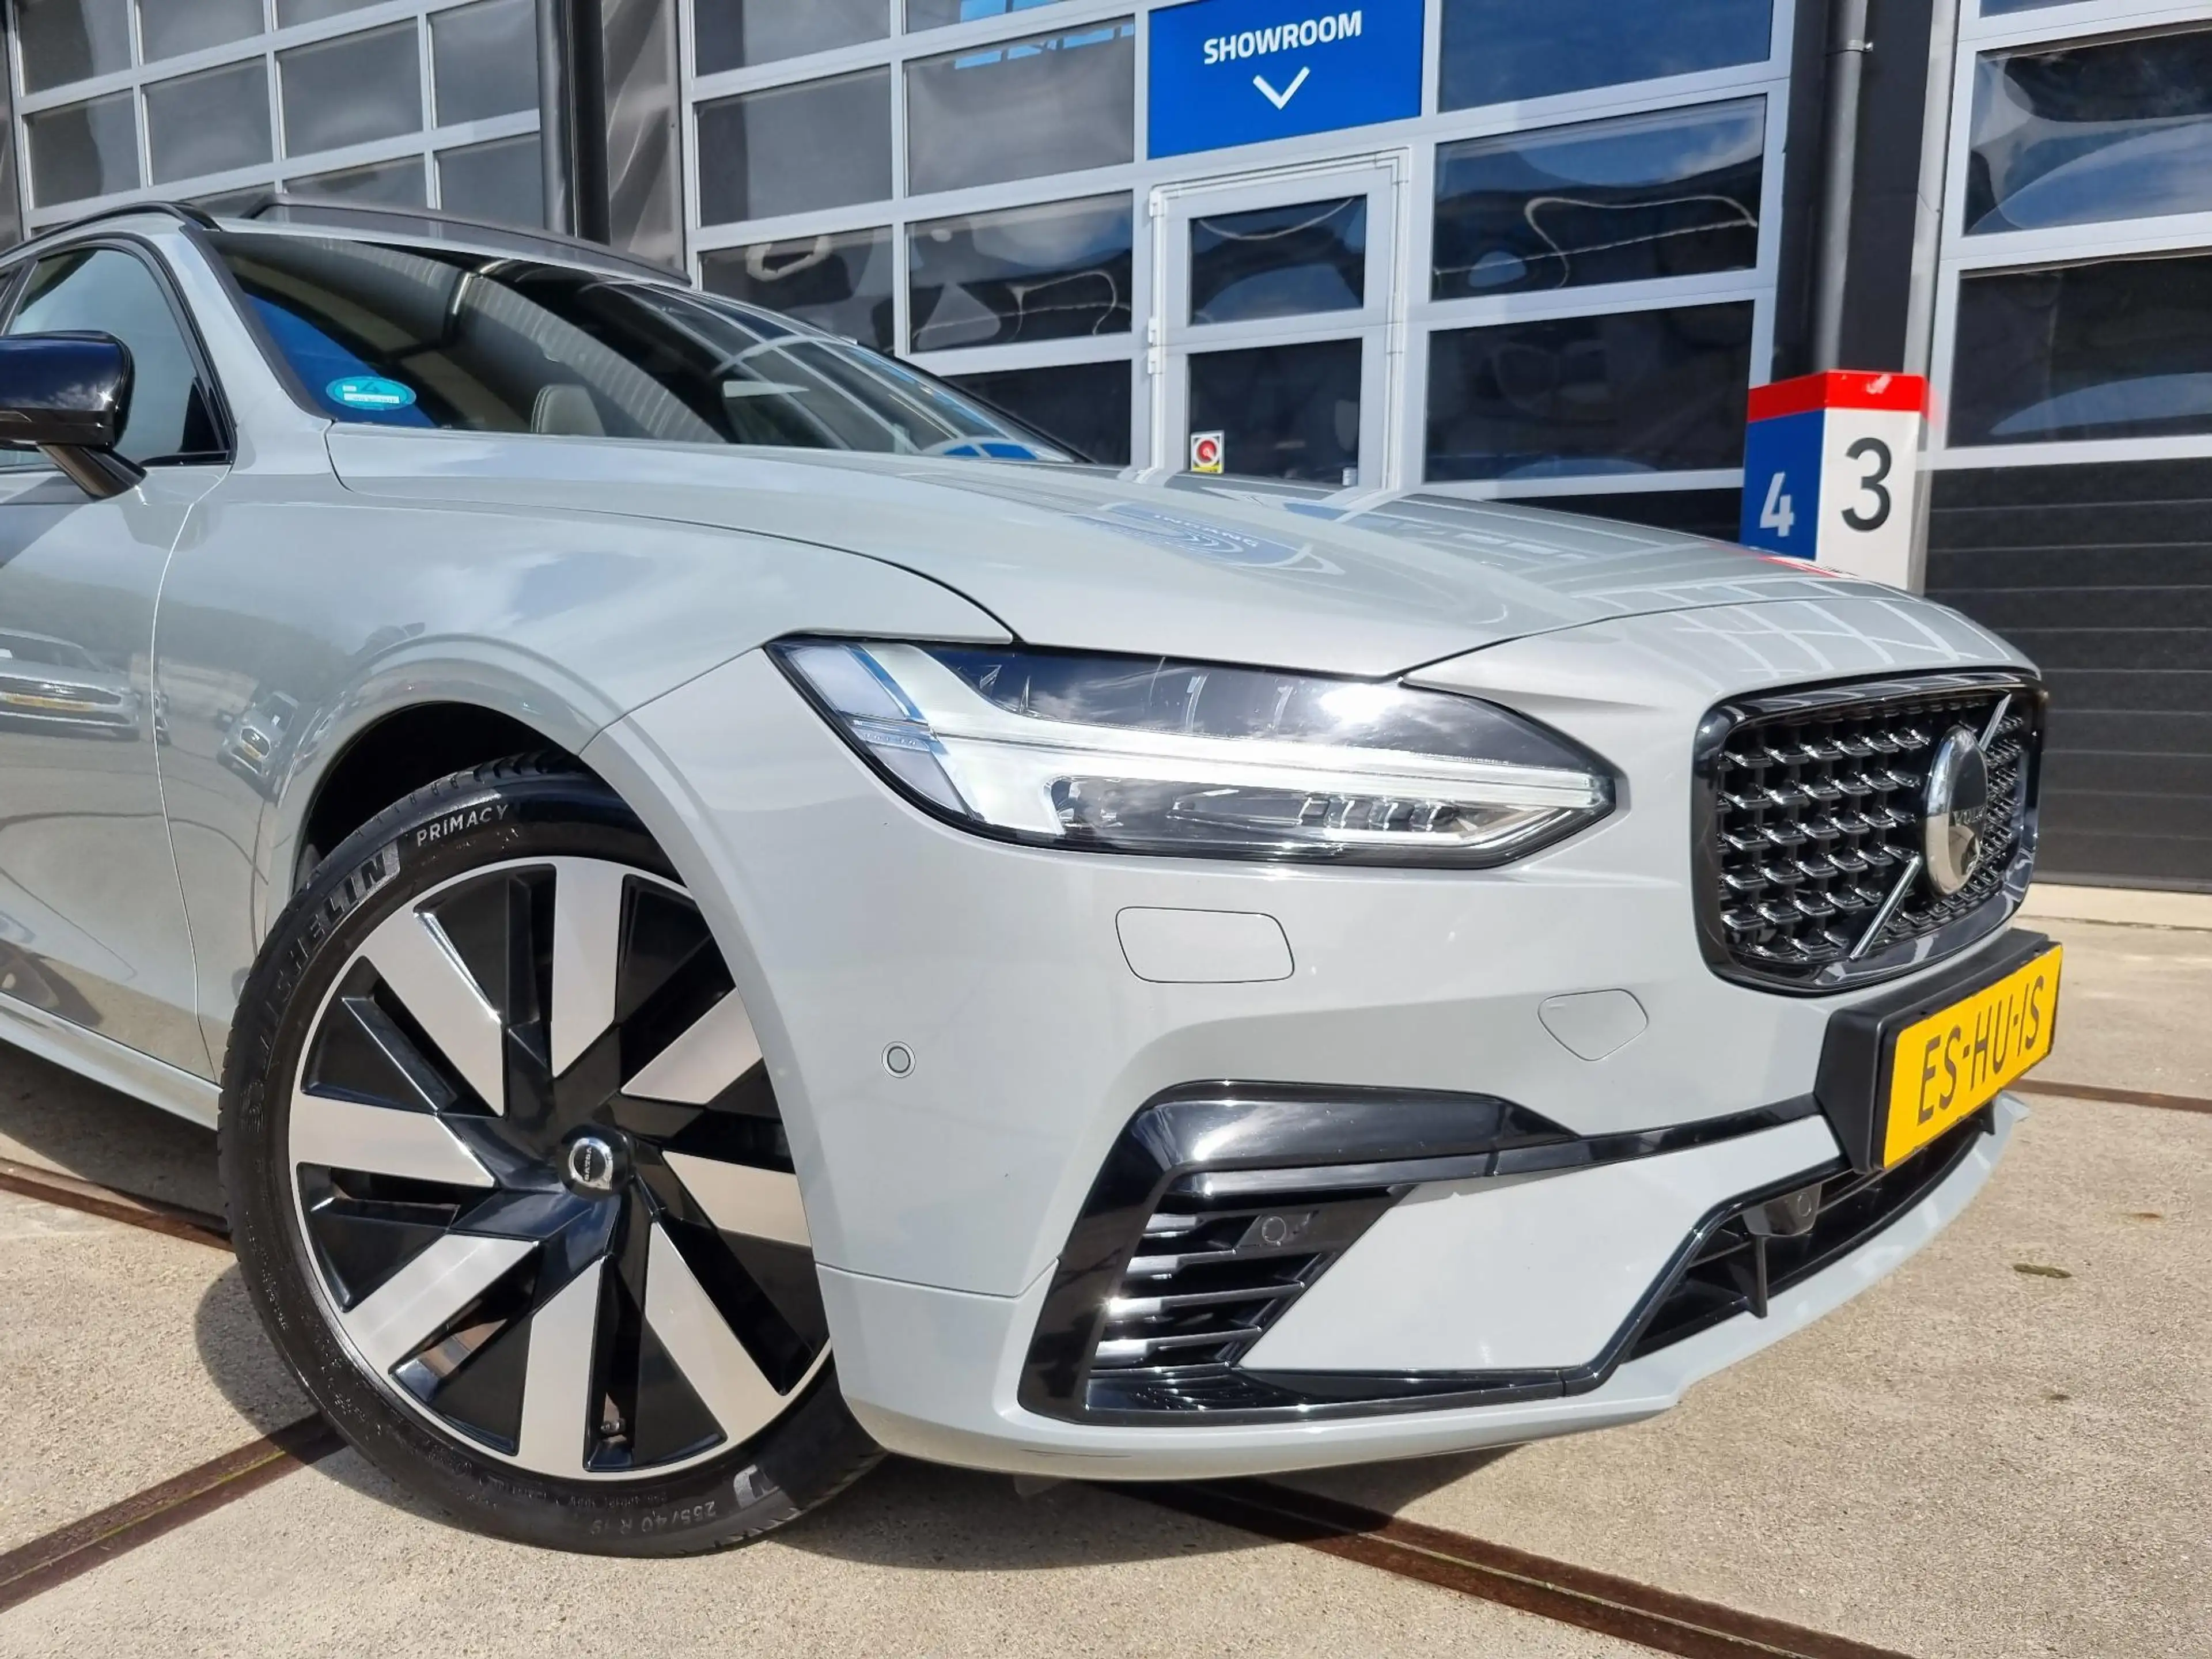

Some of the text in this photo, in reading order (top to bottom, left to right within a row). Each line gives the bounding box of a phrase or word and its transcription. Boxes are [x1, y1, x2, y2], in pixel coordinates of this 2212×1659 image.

[1203, 10, 1363, 65] SHOWROOM
[1759, 471, 1796, 537] 4
[1840, 437, 1893, 533] 3
[416, 804, 509, 847] PRIMACY
